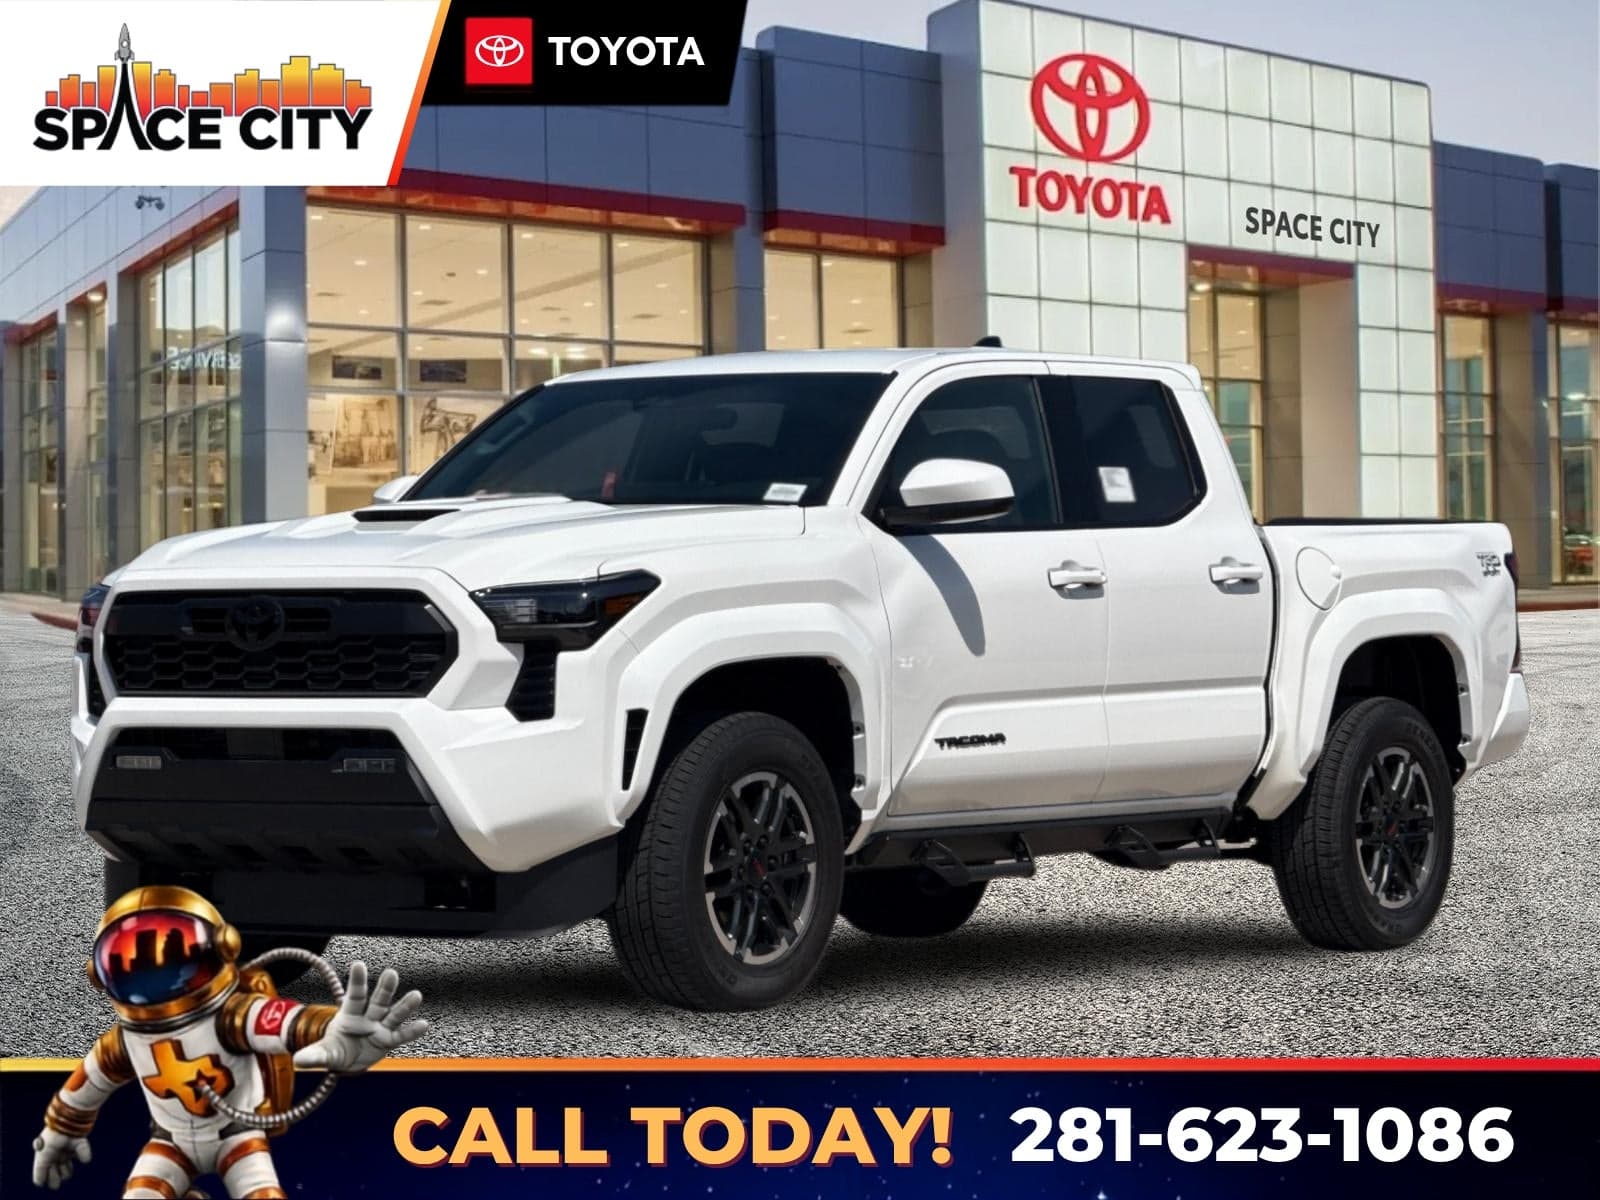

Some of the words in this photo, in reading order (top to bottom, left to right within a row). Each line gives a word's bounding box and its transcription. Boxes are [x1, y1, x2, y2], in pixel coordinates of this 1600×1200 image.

[1009, 166, 1171, 224] TOYOTA
[1245, 206, 1323, 242] SPACE
[1329, 218, 1381, 248] CITY
[934, 732, 1007, 751] TACOMA
